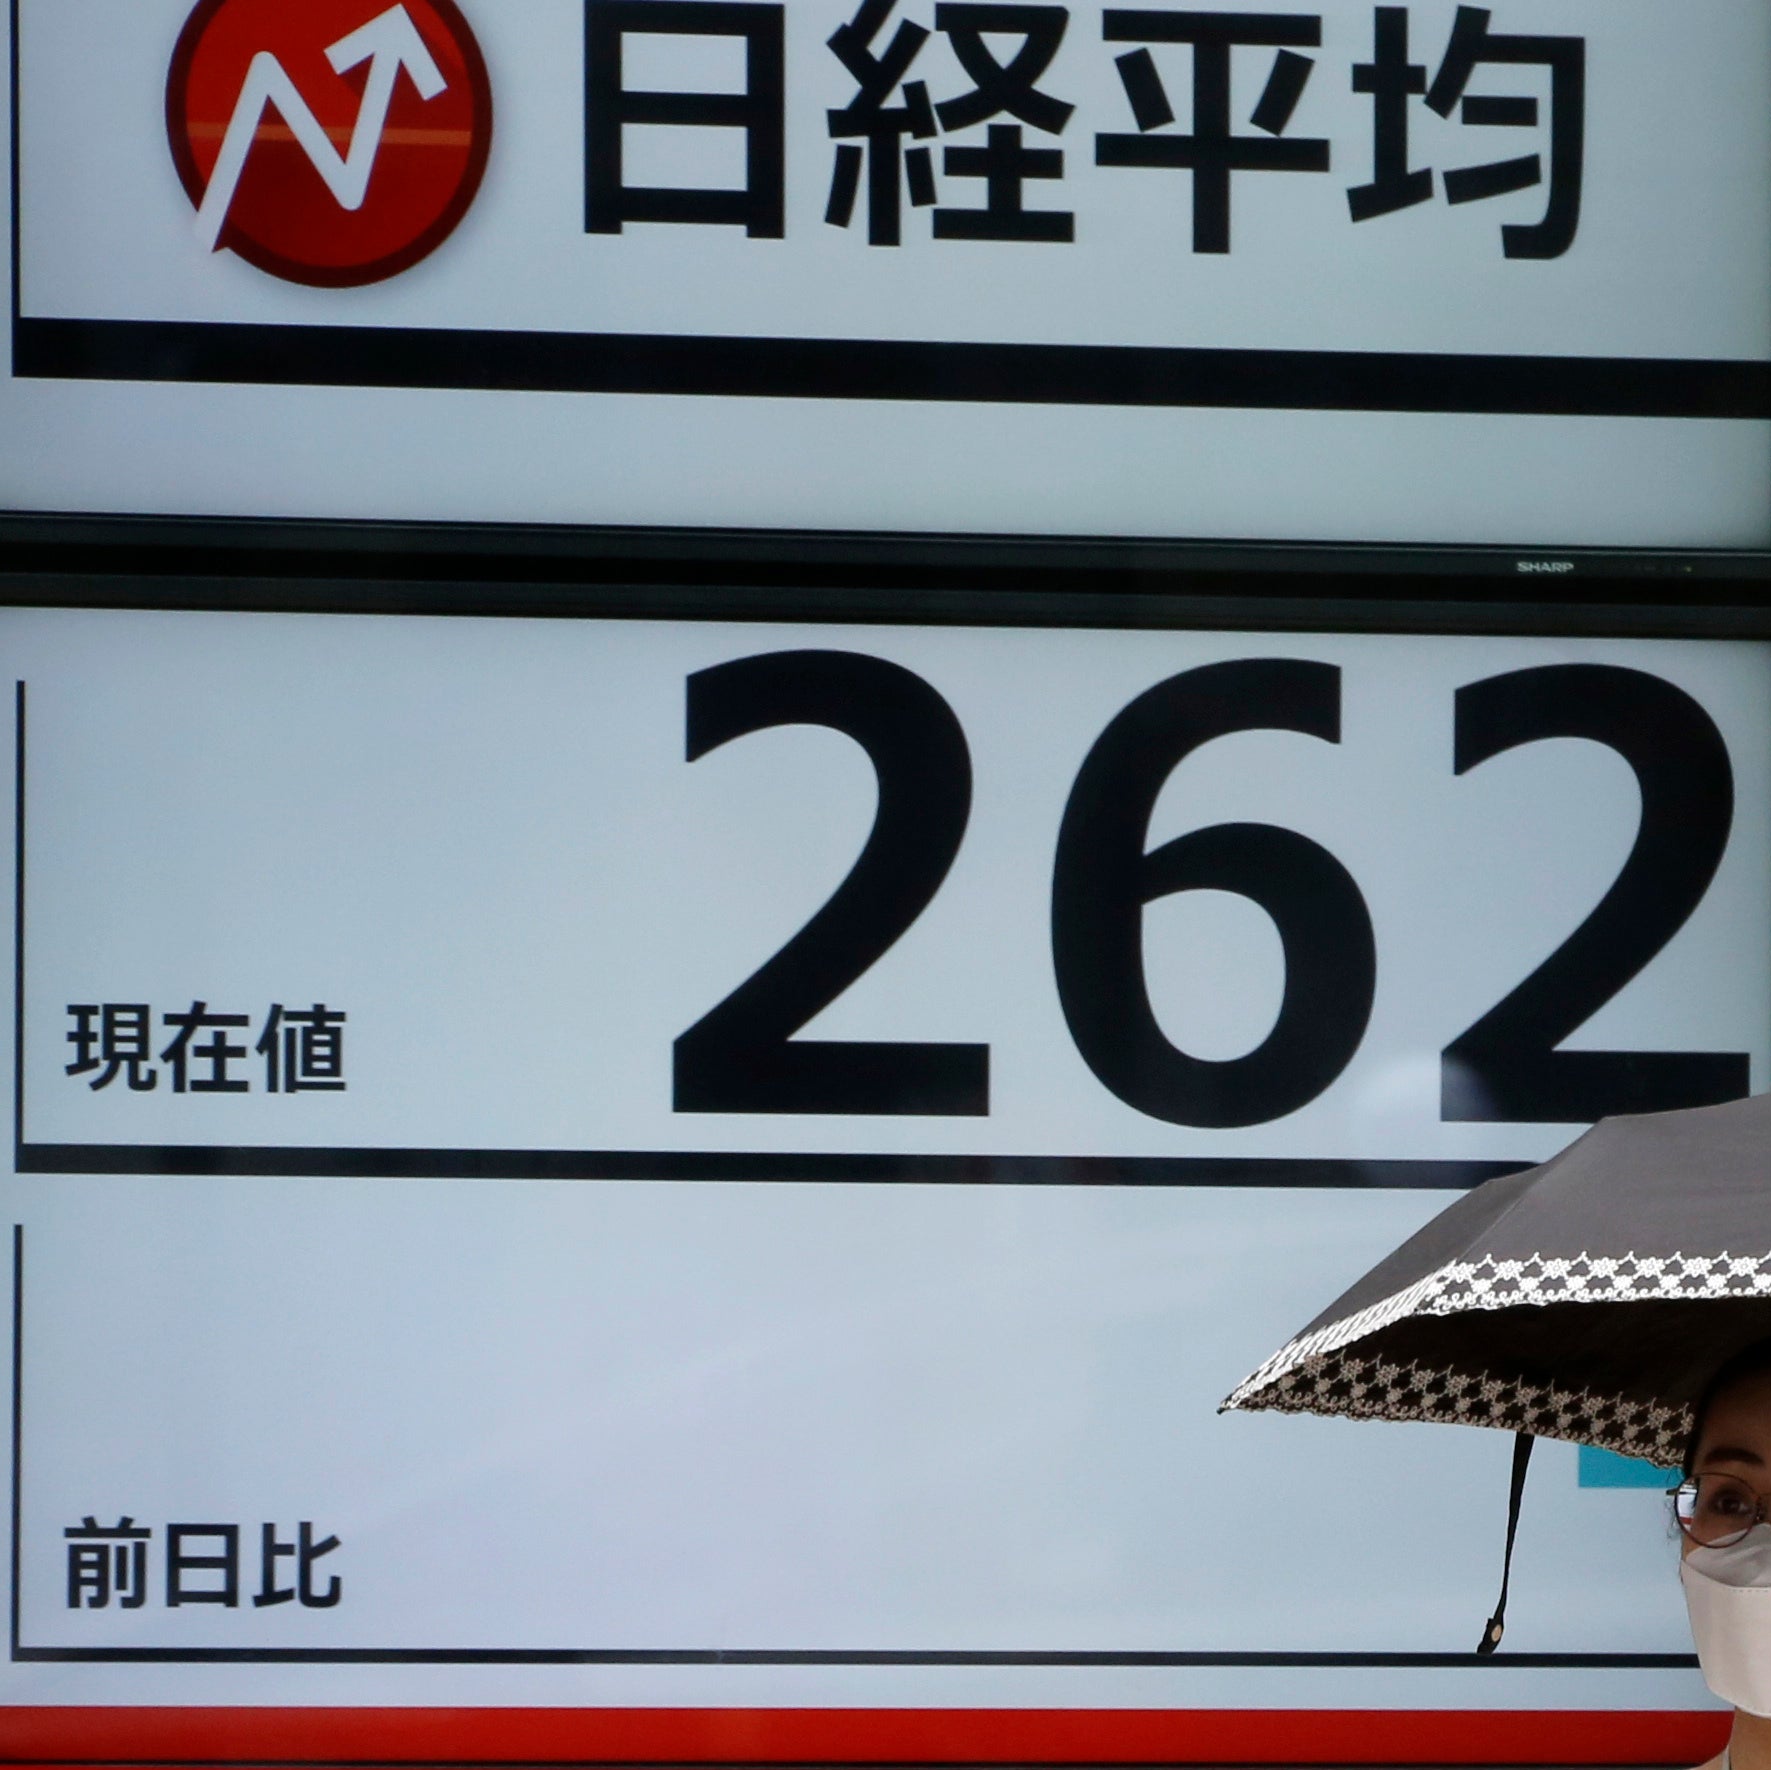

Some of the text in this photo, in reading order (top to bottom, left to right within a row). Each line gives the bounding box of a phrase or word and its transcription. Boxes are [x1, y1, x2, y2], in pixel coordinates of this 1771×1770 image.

[583, 0, 1587, 261] 日経平均
[1516, 561, 1575, 573] SHARP
[65, 1000, 348, 1096] 現在値
[63, 1516, 344, 1613] 前日比
